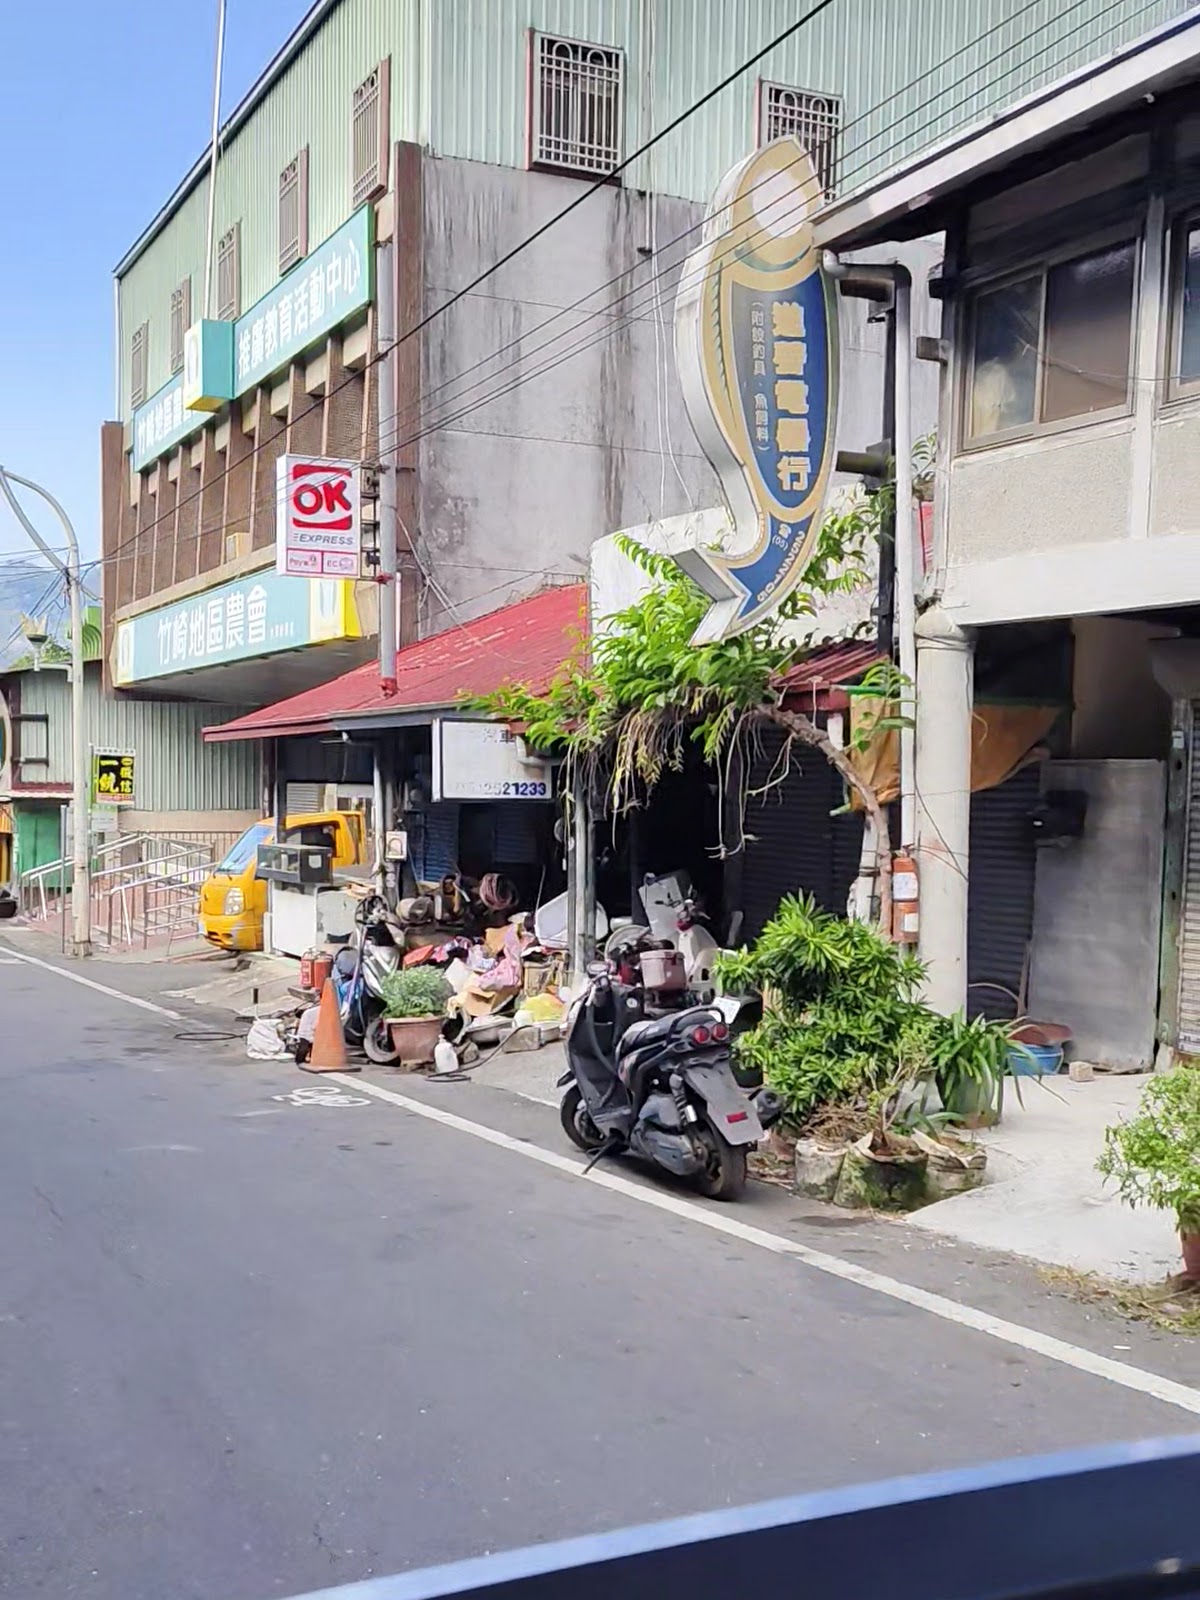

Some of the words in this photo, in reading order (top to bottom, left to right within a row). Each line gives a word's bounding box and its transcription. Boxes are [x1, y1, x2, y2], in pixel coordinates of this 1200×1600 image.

[137, 387, 193, 456] 竹崎地區農
[293, 480, 352, 515] OK
[300, 533, 354, 545] EXPRESS
[158, 584, 268, 666] 竹崎地區農會
